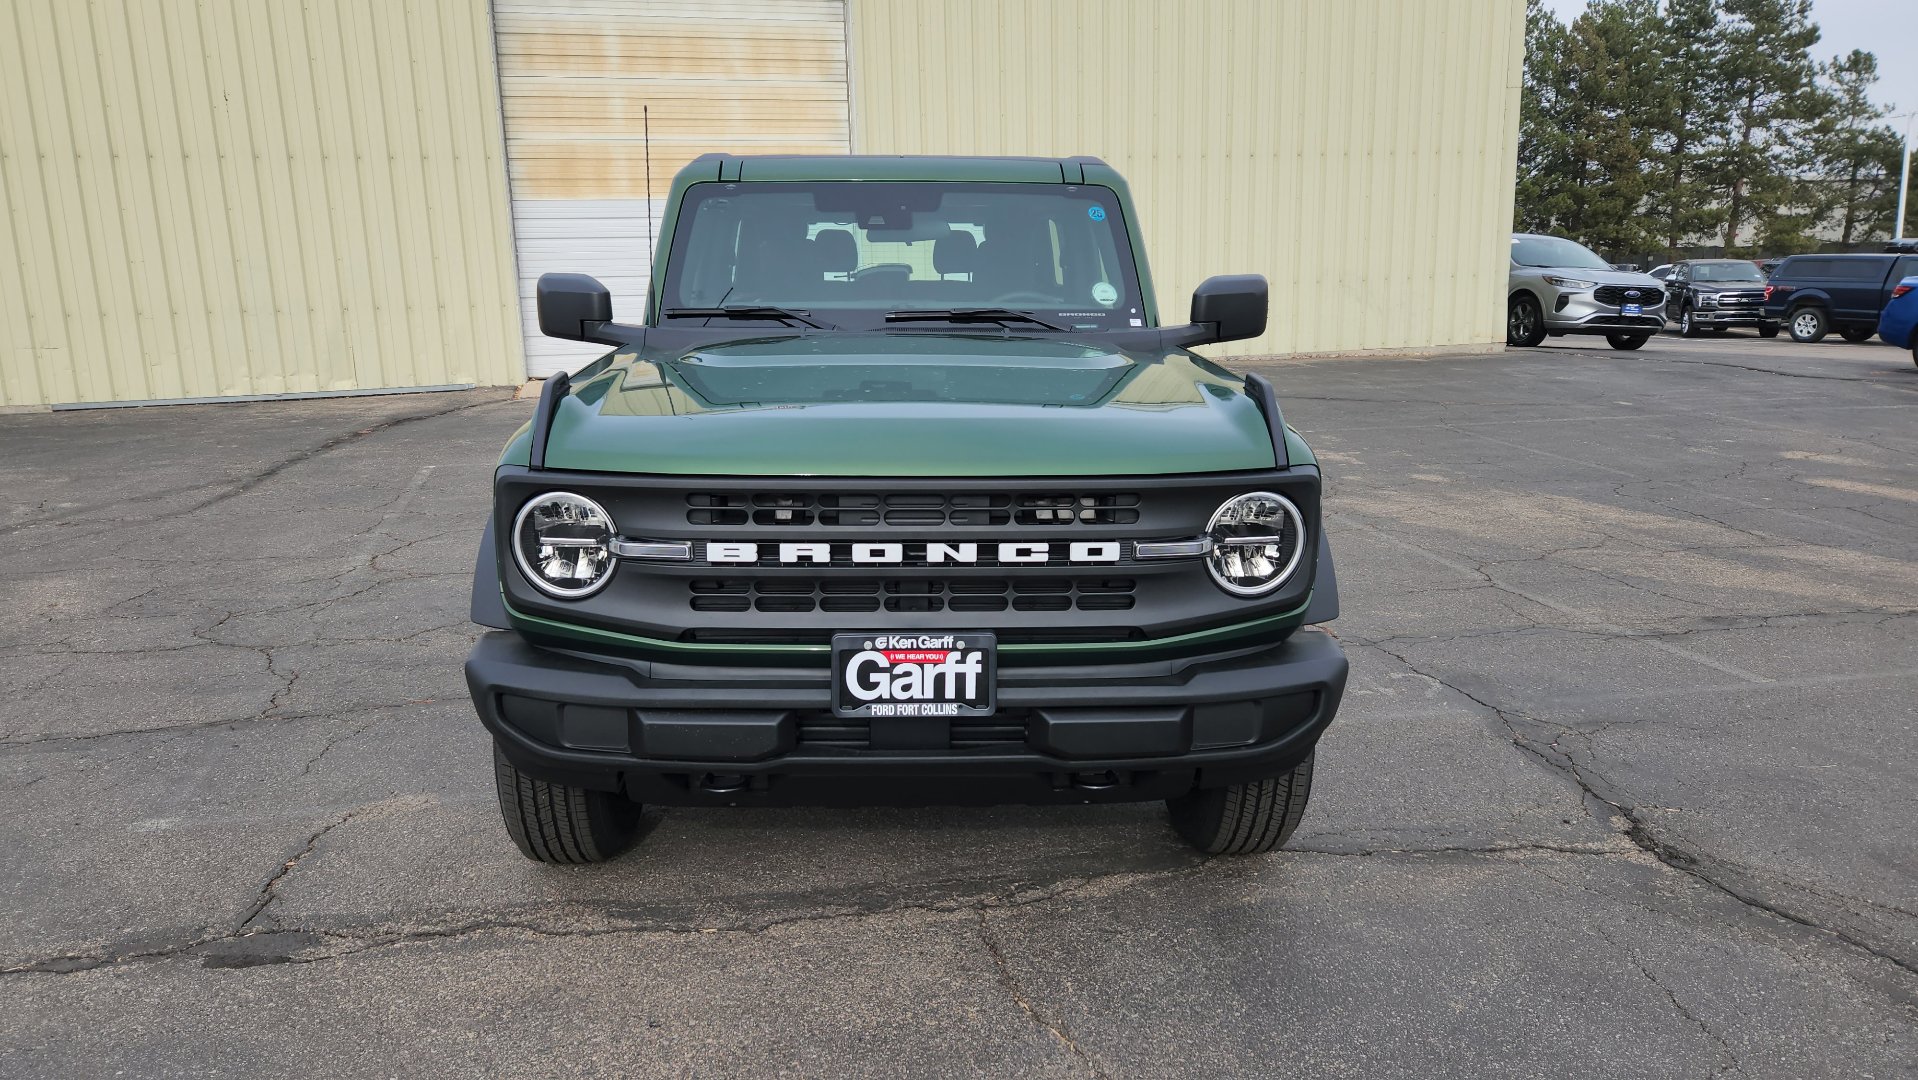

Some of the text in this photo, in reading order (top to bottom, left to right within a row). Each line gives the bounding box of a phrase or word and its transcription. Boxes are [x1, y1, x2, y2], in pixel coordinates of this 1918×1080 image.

[1090, 209, 1103, 218] 25
[706, 541, 1121, 563] BRONCO
[889, 635, 954, 649] Ken Garff
[845, 650, 982, 701] Garff
[871, 703, 958, 716] FORD FORT COLLINS
